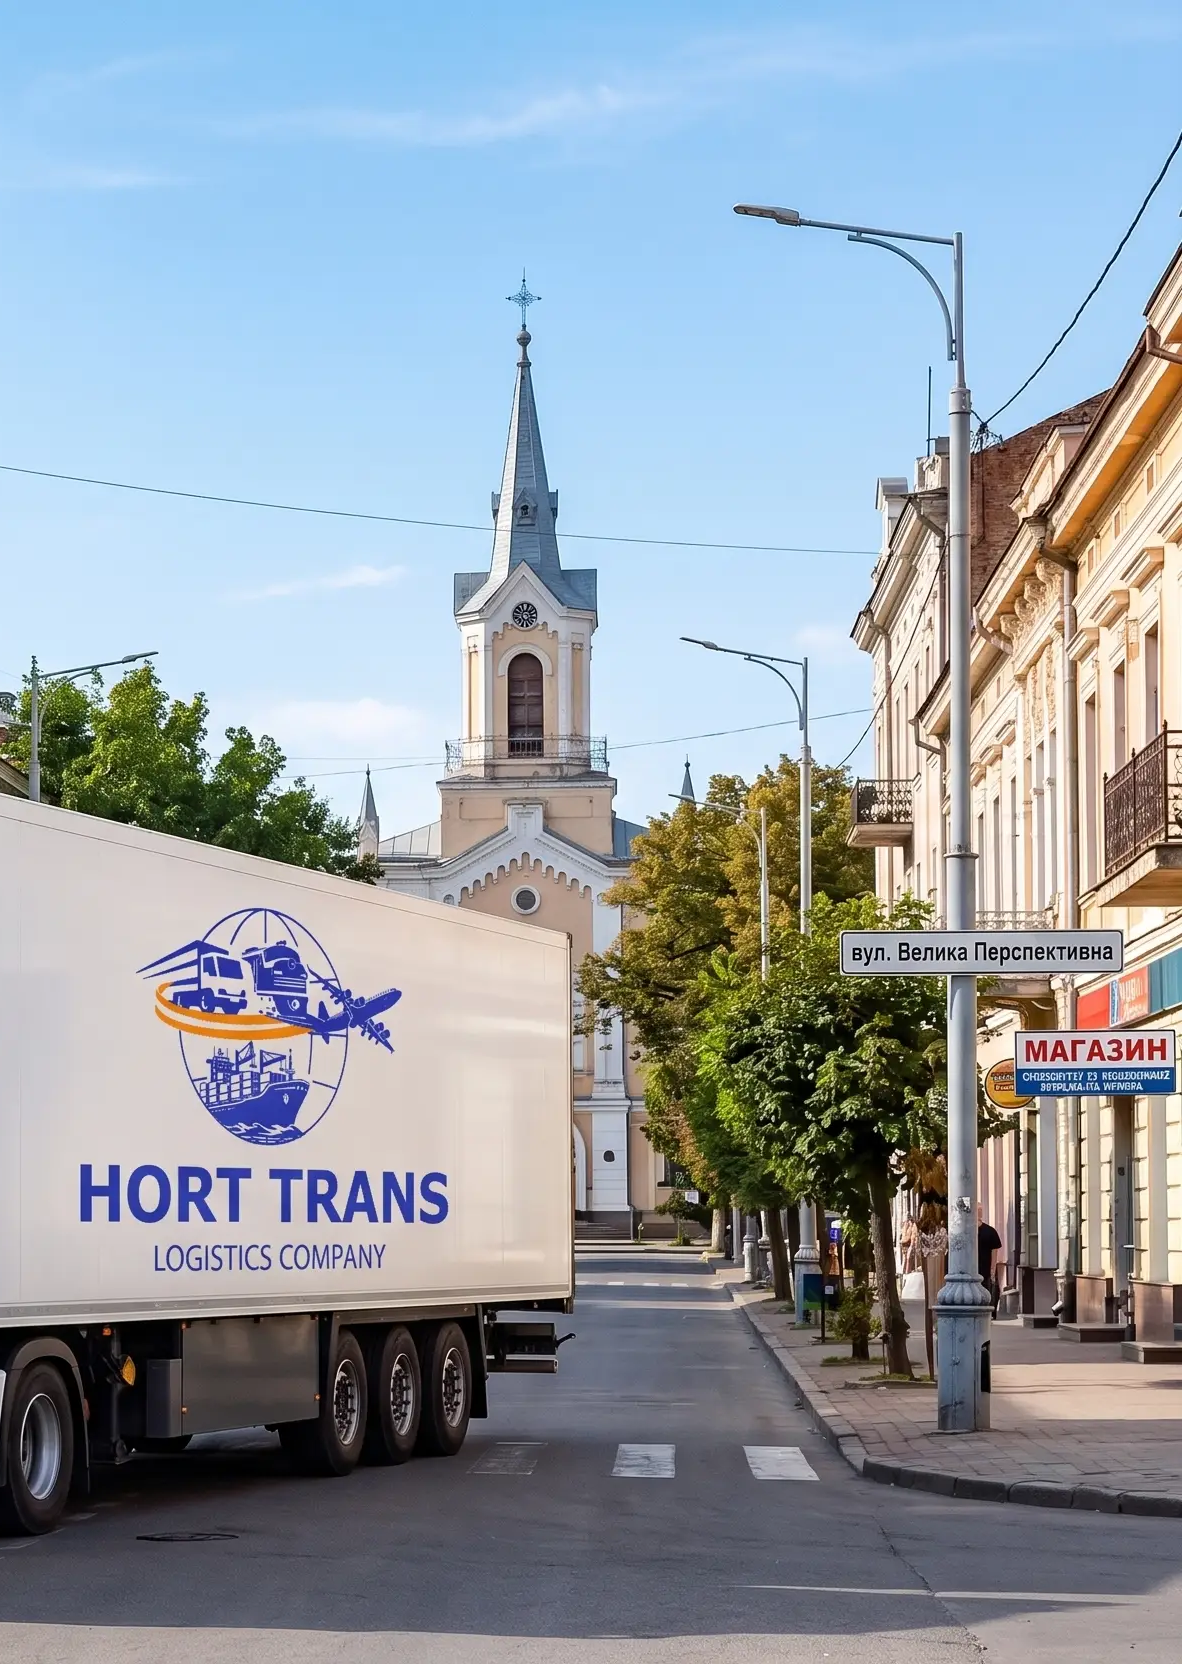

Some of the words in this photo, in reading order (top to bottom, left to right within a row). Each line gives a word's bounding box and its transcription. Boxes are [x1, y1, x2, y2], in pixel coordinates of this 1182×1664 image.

[851, 946, 891, 967] вул.
[898, 942, 968, 962] Велика
[974, 941, 1113, 967] Перспективна
[1024, 1038, 1167, 1063] МАГАЗИН
[79, 1164, 252, 1223] HORT
[269, 1168, 449, 1225] TRANS
[153, 1243, 273, 1273] LOGISTICS
[279, 1243, 386, 1271] COMPANY
